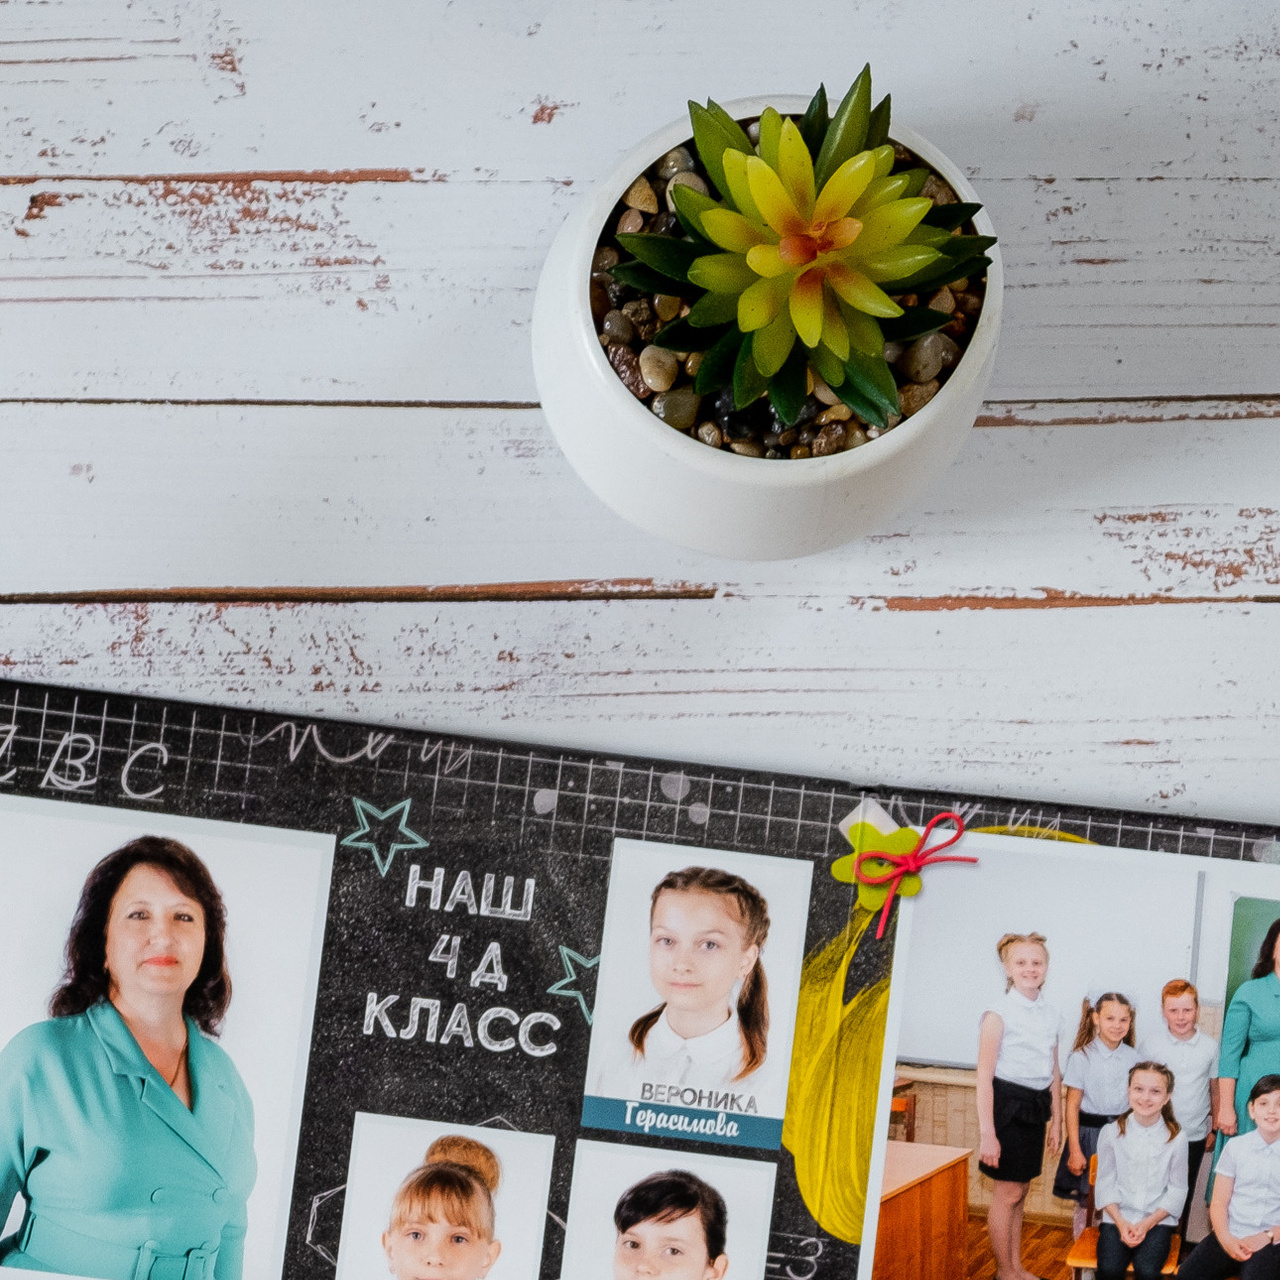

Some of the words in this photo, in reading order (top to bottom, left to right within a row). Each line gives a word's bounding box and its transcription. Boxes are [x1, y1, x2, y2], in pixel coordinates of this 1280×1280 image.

[405, 864, 536, 922] НАШ
[428, 934, 461, 979] 4
[362, 992, 562, 1058] КЛАСС
[625, 1101, 740, 1139] Герасимова
[641, 1082, 759, 1114] ВЕРОНИКА
